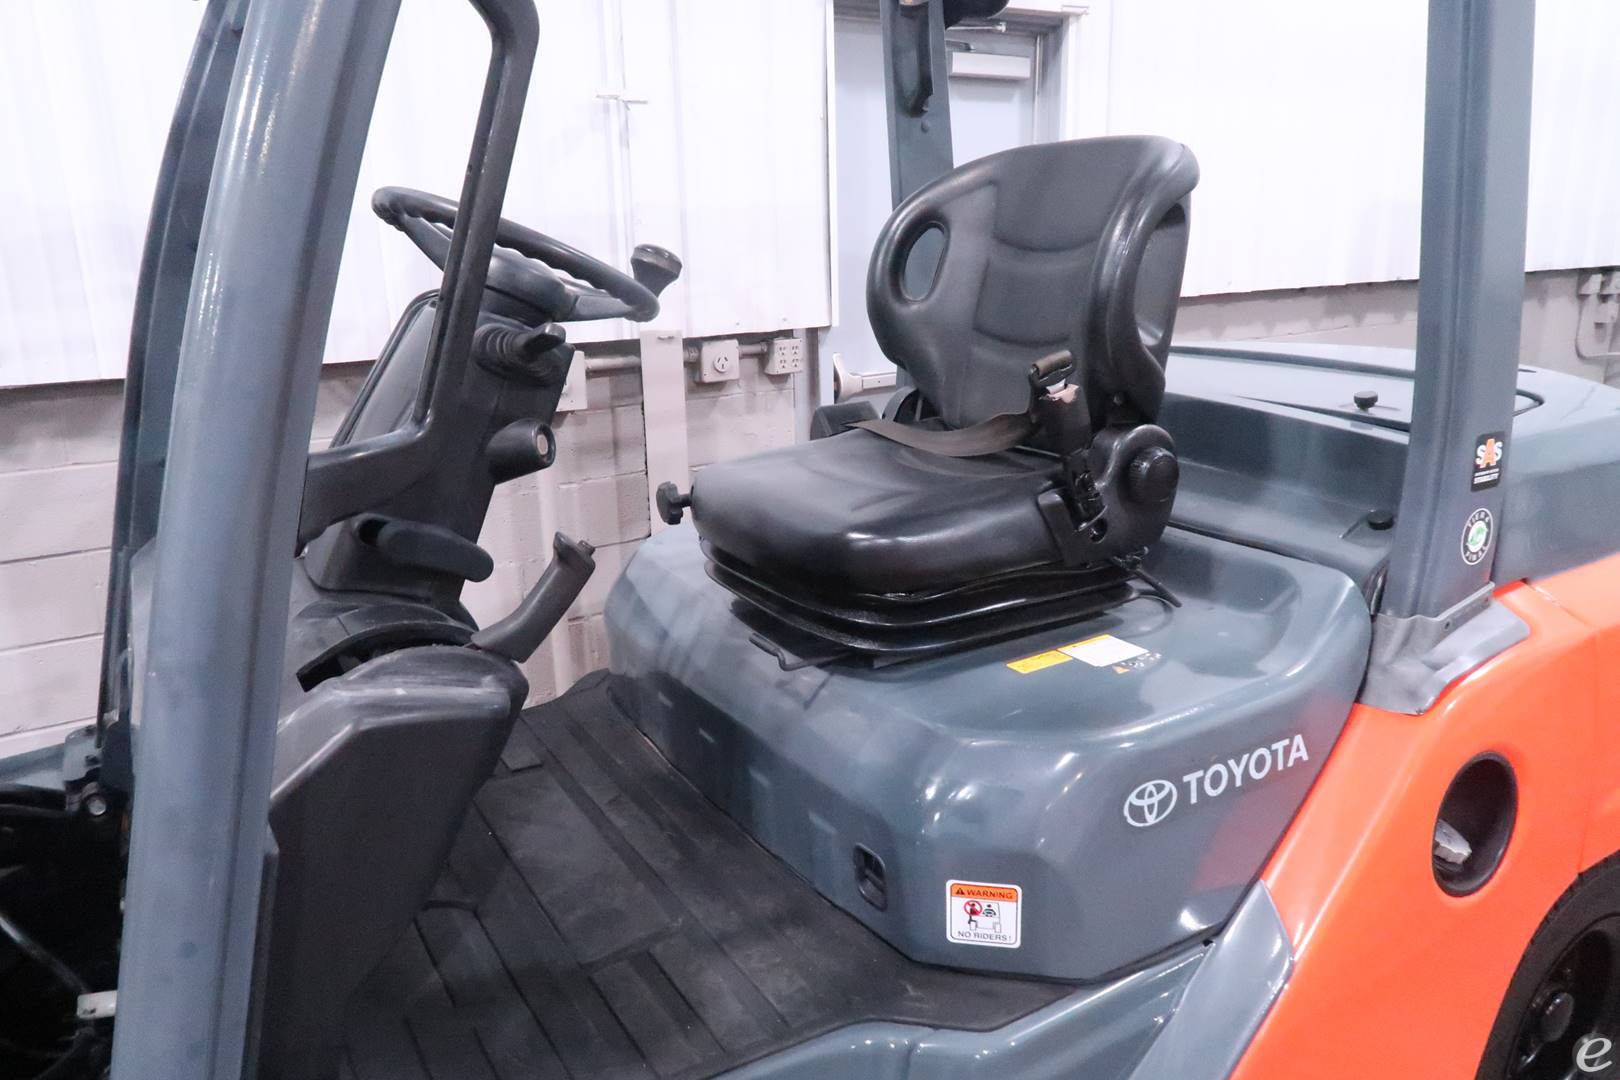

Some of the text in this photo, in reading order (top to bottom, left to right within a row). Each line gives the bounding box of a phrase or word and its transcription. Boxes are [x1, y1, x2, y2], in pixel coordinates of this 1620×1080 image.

[1182, 734, 1309, 804] TOYOTA
[966, 889, 1013, 900] WARNING
[958, 930, 971, 938] NO
